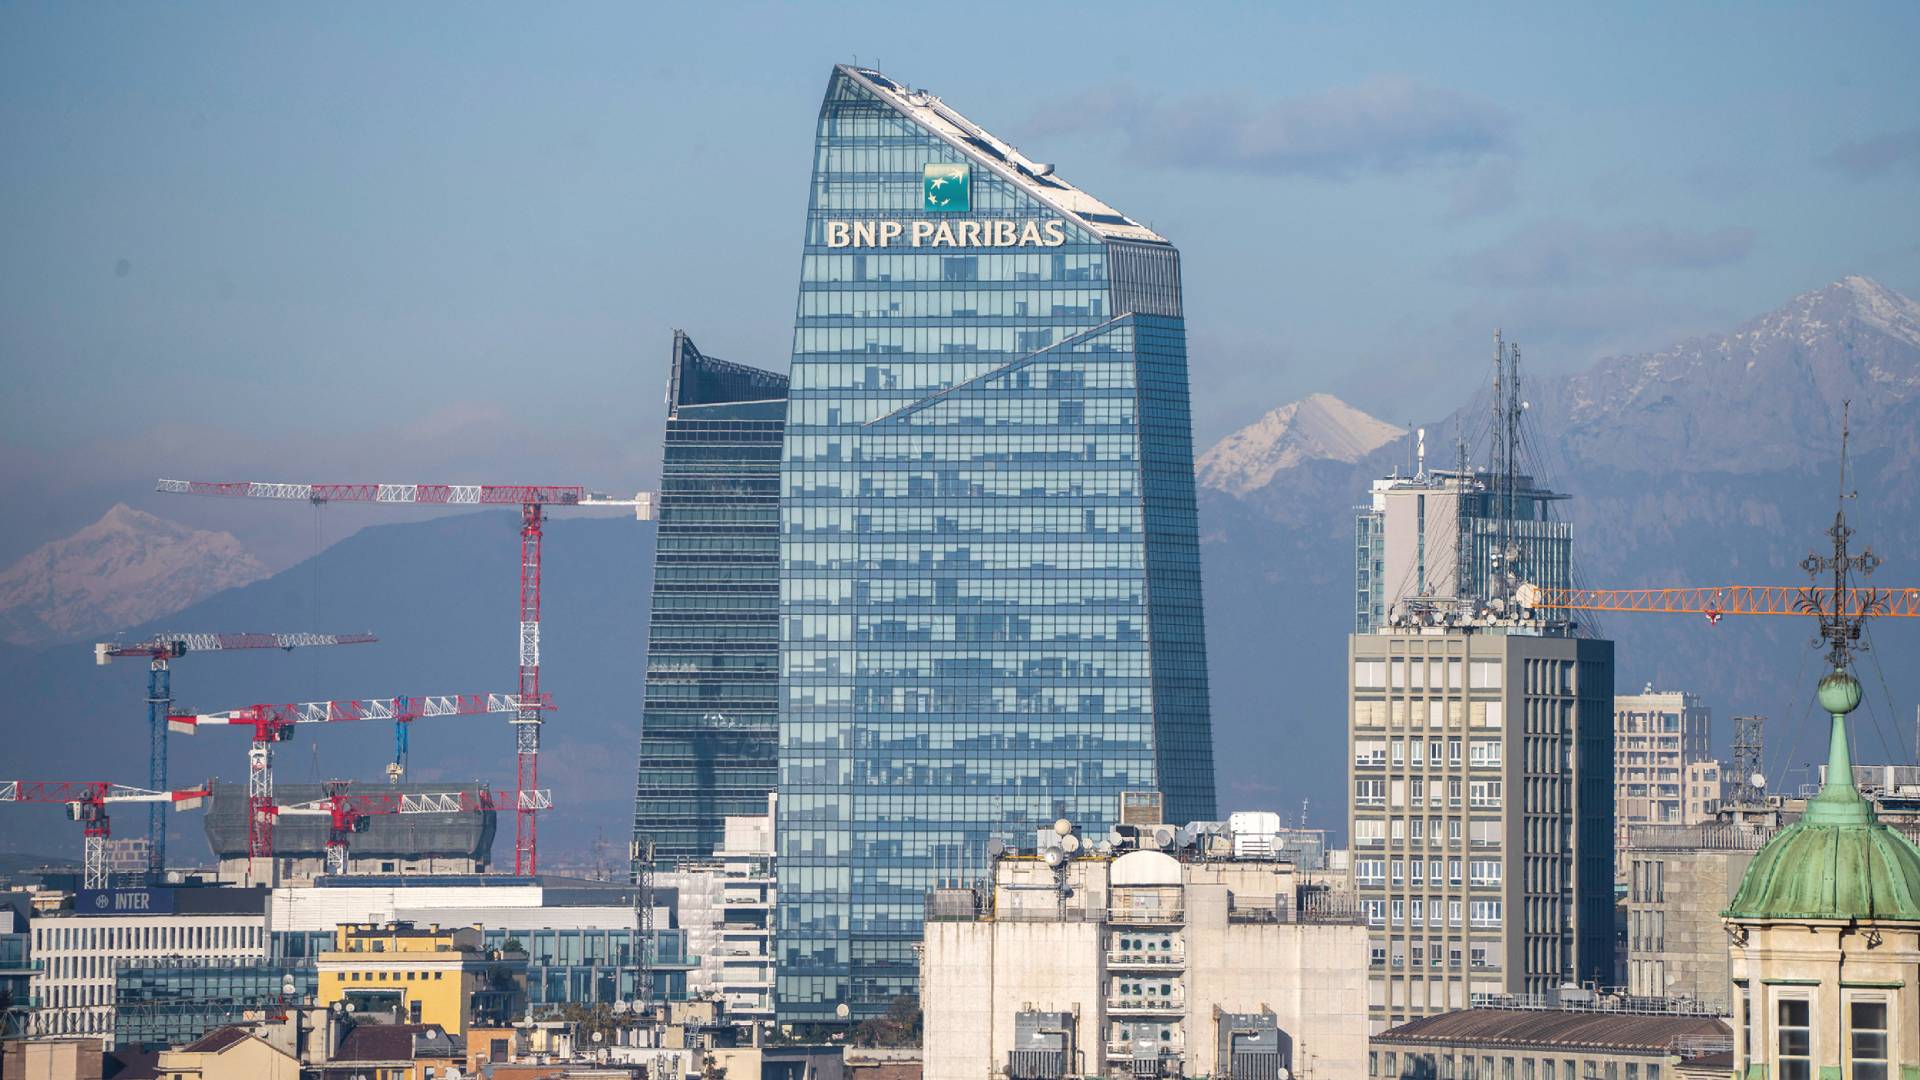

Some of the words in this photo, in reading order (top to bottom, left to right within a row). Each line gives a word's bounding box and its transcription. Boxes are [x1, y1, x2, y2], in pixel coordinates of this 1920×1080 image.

[828, 221, 902, 248] BNP
[912, 220, 1065, 248] PARIBAS
[115, 893, 149, 909] INTER
